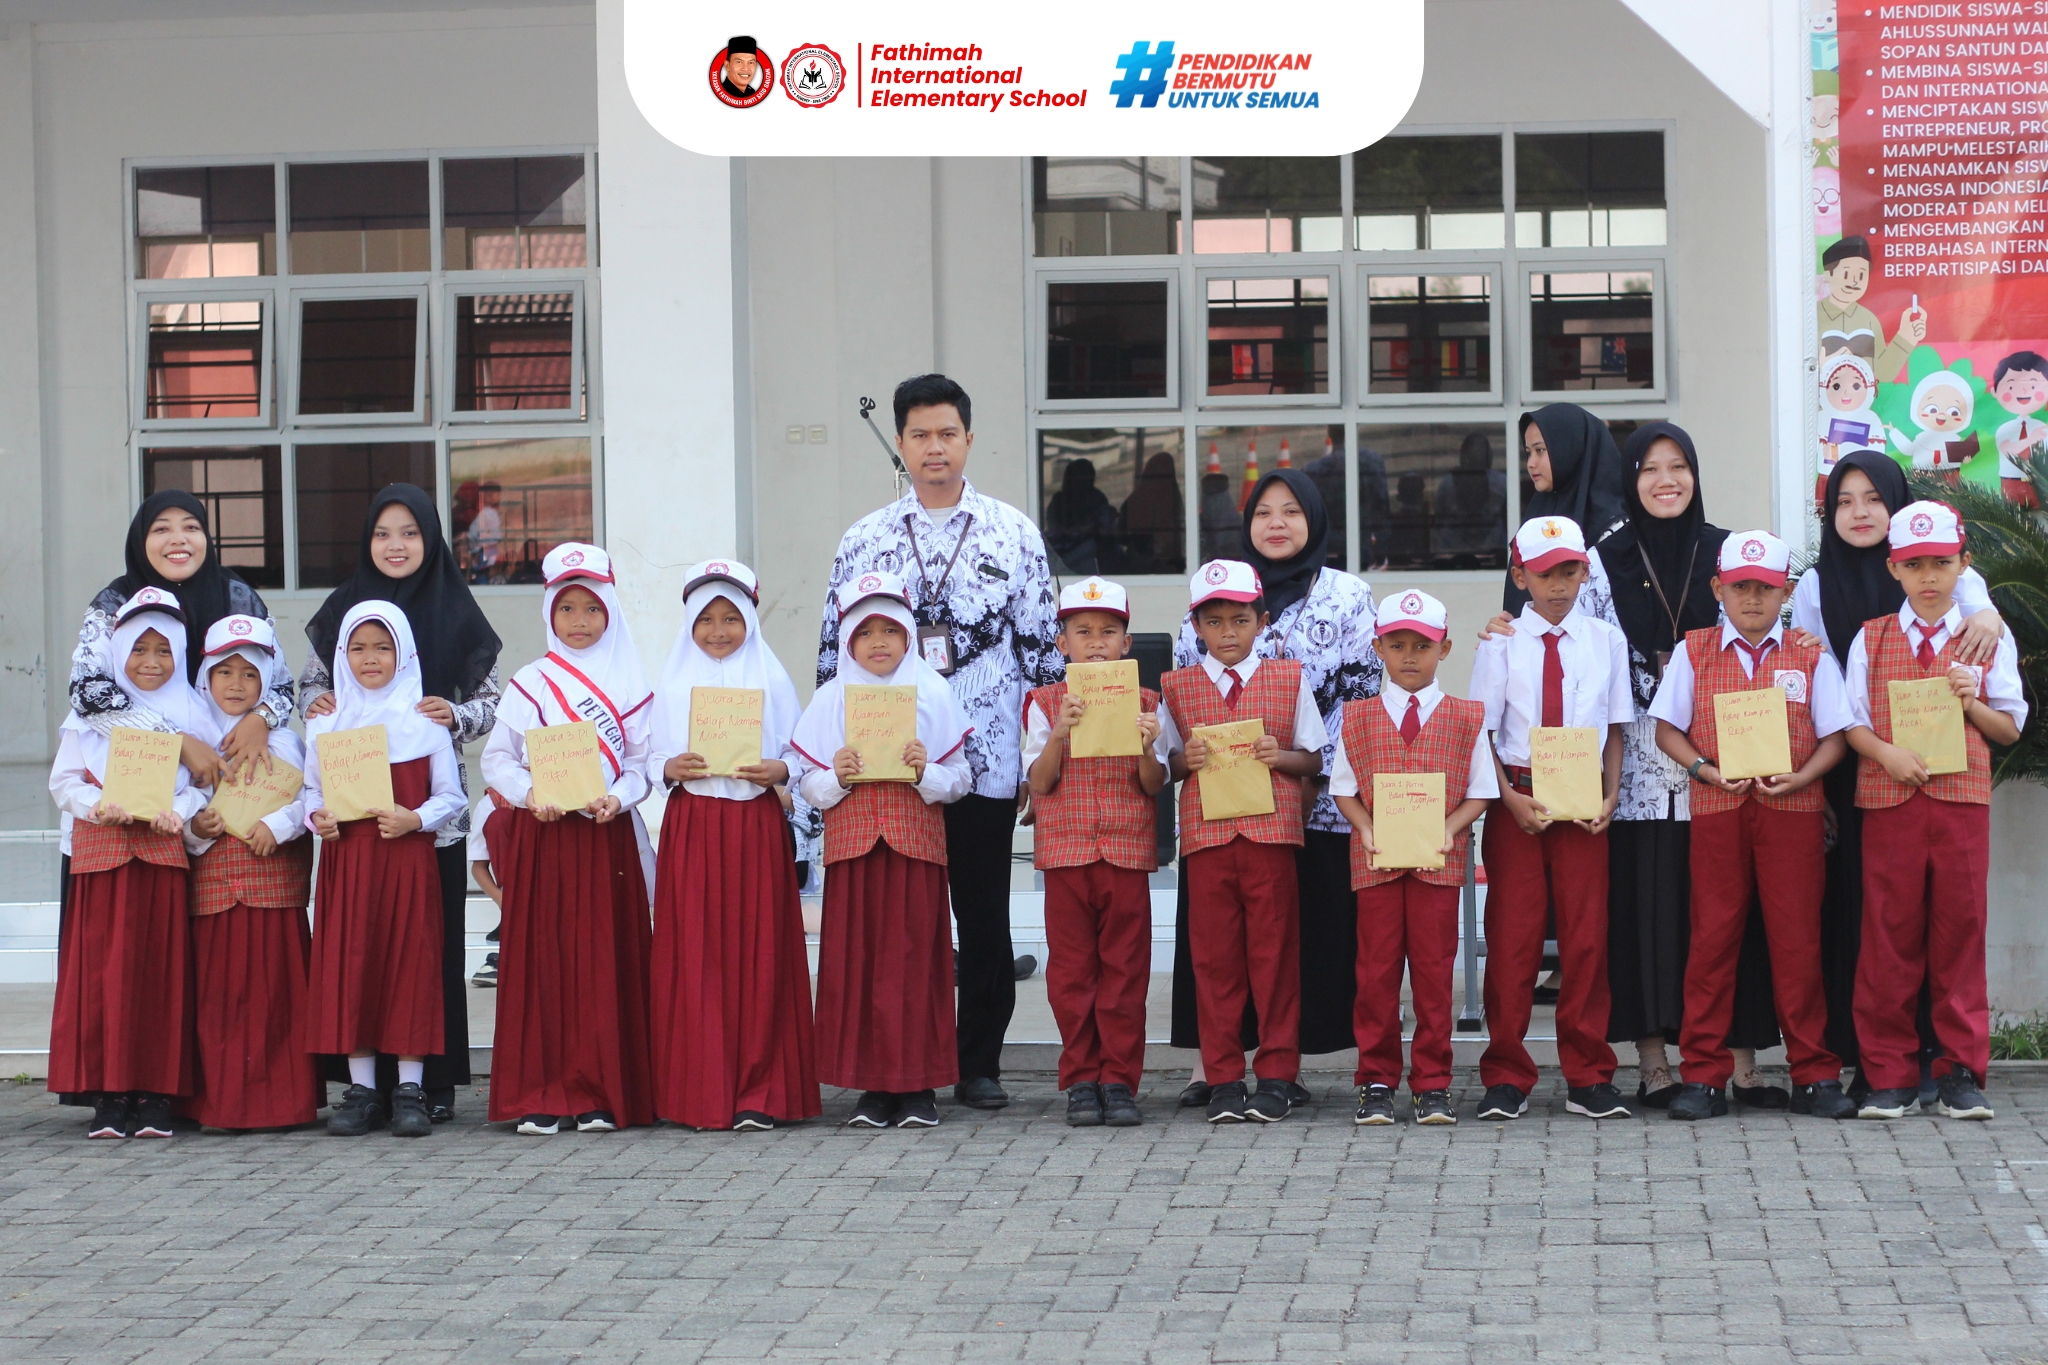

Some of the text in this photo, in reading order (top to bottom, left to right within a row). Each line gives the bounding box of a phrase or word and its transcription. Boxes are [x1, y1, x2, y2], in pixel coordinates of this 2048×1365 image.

[1880, 4, 1962, 19] MENDIDIK
[1881, 24, 2008, 39] AHLUSSUNNAH
[1881, 41, 2048, 59] SOPAN SANTUN DA
[1882, 64, 1962, 79] MEMBINA
[1882, 80, 2048, 99] DAN INTERNATIONA
[1882, 102, 2006, 118] MENCIPTAKAN
[1883, 121, 2015, 138] ENTREPRENEUR,
[1884, 144, 1948, 158] MAMPU
[1884, 161, 2009, 177] MENANAMKAN
[1884, 180, 2048, 198] BANGSA INDONESIA
[1884, 199, 2048, 217] MODERAT DAN MEL
[1885, 220, 2044, 237] MENGEMBANGKAN
[1885, 239, 2048, 257] BERBAHASA INTERN
[1885, 259, 2048, 277] BERPARTISIPASI DA
[576, 696, 624, 752] PETUGAS
[696, 714, 724, 729] Balap
[567, 731, 574, 740] 3
[324, 738, 352, 757] Juara
[358, 736, 366, 744] 3
